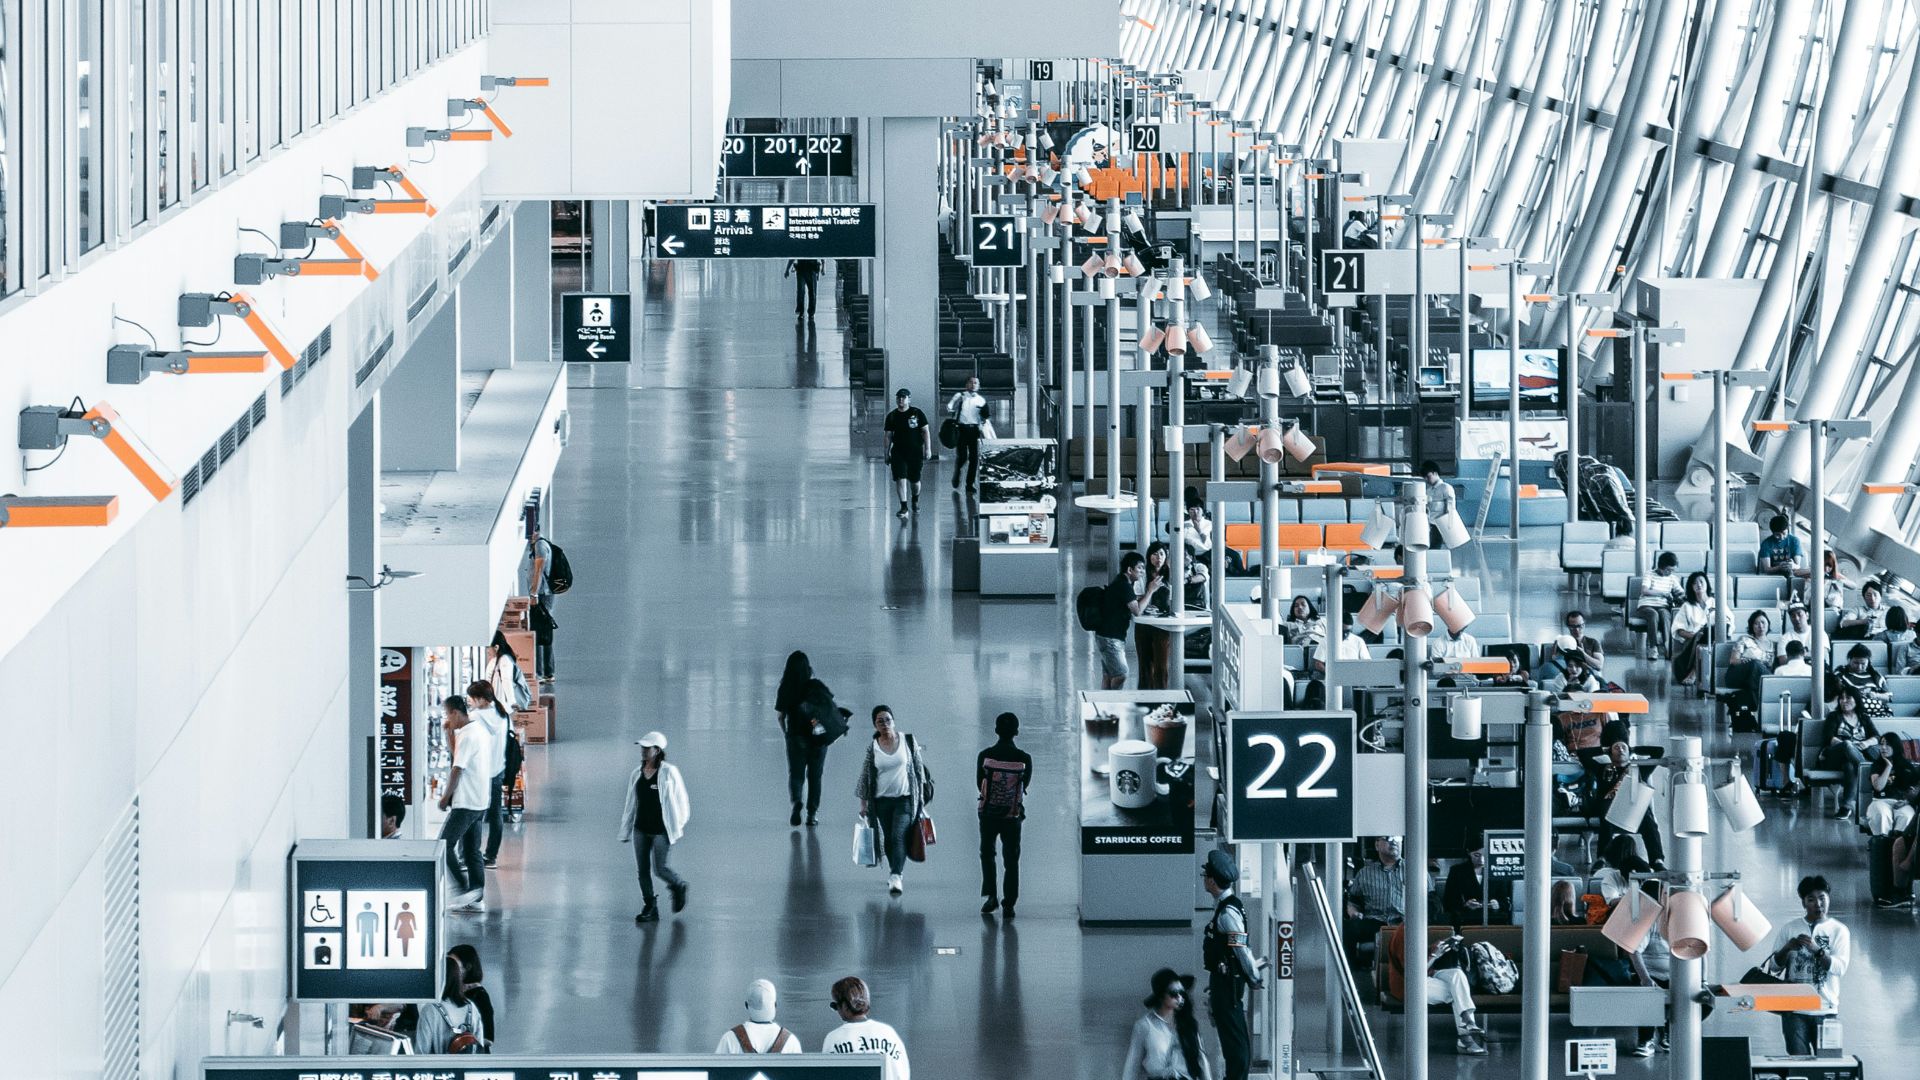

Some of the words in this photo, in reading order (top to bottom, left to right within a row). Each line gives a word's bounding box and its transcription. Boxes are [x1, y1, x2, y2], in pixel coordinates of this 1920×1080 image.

[1037, 63, 1050, 80] 19
[1137, 127, 1156, 149] 20
[713, 208, 751, 223] 到着
[788, 217, 832, 225] International
[832, 217, 861, 225] Transfer
[714, 224, 753, 235] Arrivals
[979, 222, 1014, 250] 21
[1333, 256, 1358, 289] 21
[1246, 733, 1338, 799] 22
[1094, 836, 1148, 844] STARBUCKS
[1149, 836, 1182, 844] COFFEE
[1280, 940, 1292, 978] AED
